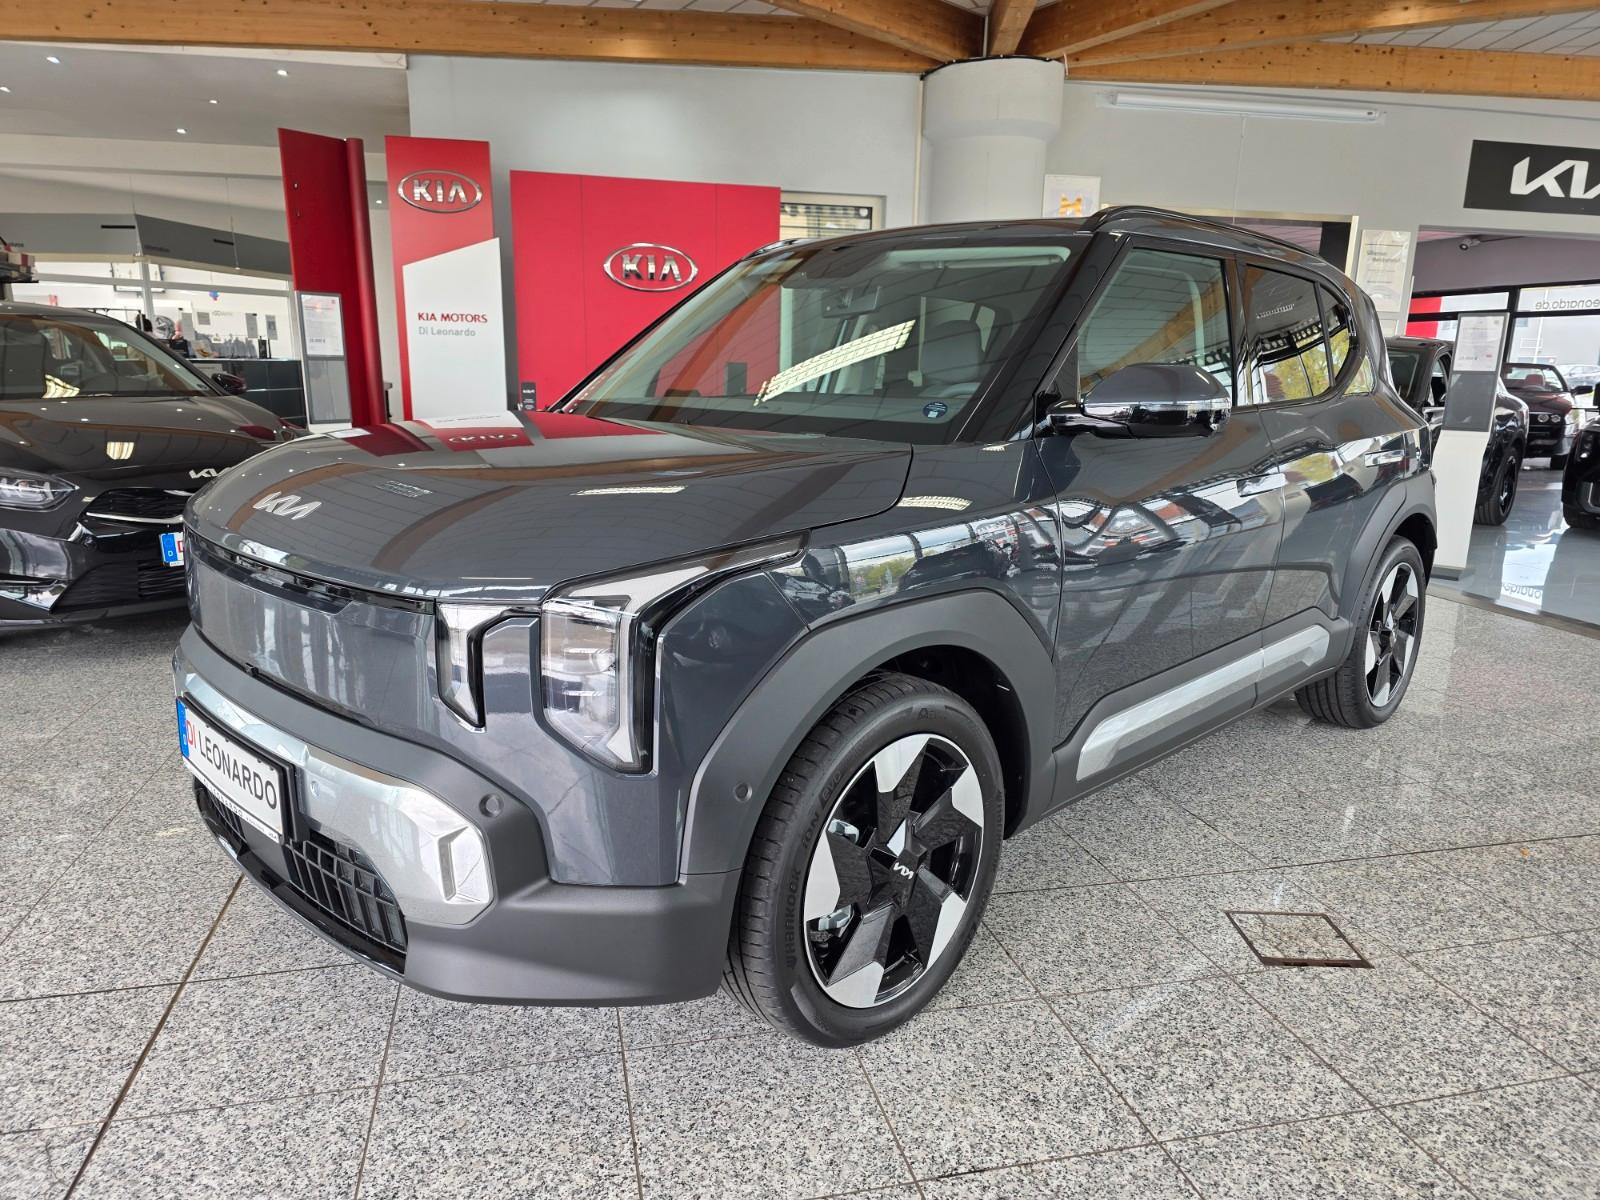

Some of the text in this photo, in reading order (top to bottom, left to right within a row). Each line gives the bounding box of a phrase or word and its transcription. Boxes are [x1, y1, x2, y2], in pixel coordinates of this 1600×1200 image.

[412, 179, 468, 203] KIA
[622, 253, 682, 282] KIA
[417, 312, 488, 323] KIA MOTORS
[418, 326, 476, 337] Di Leonardo
[252, 491, 322, 520] KIA
[186, 719, 197, 749] DI
[198, 731, 277, 810] LEONARDO
[893, 861, 915, 880] KIA
